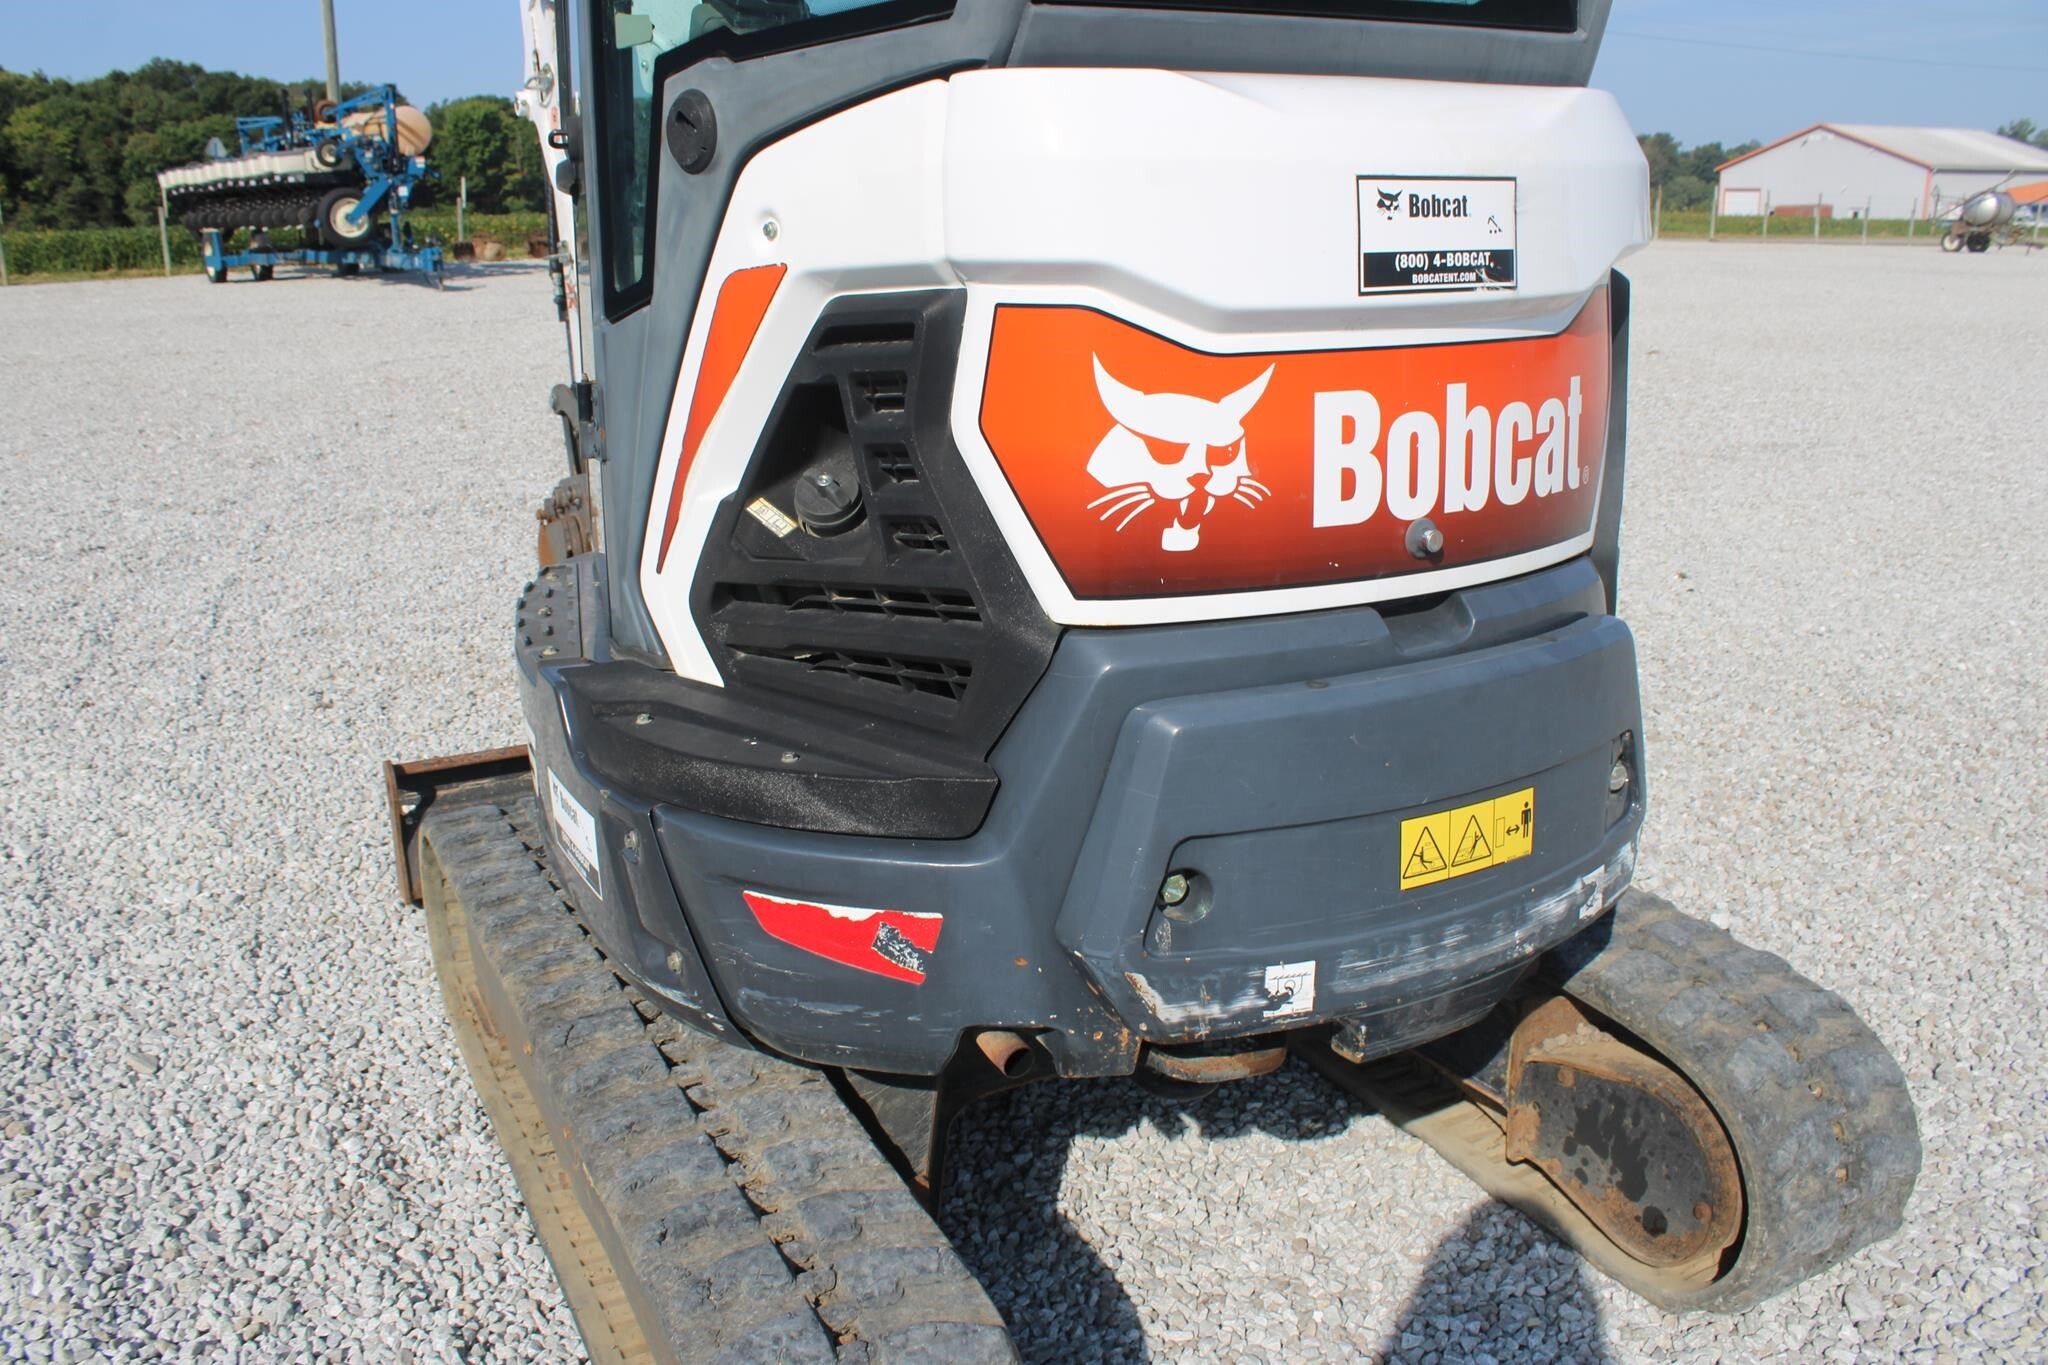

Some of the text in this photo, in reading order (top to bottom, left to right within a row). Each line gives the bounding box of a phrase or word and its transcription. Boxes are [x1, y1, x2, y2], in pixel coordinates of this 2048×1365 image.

[1408, 193, 1468, 218] Bobcat
[1395, 253, 1429, 272] (800)
[1412, 271, 1477, 284] BOBCATENT.COM
[1312, 375, 1583, 528] Bobcat
